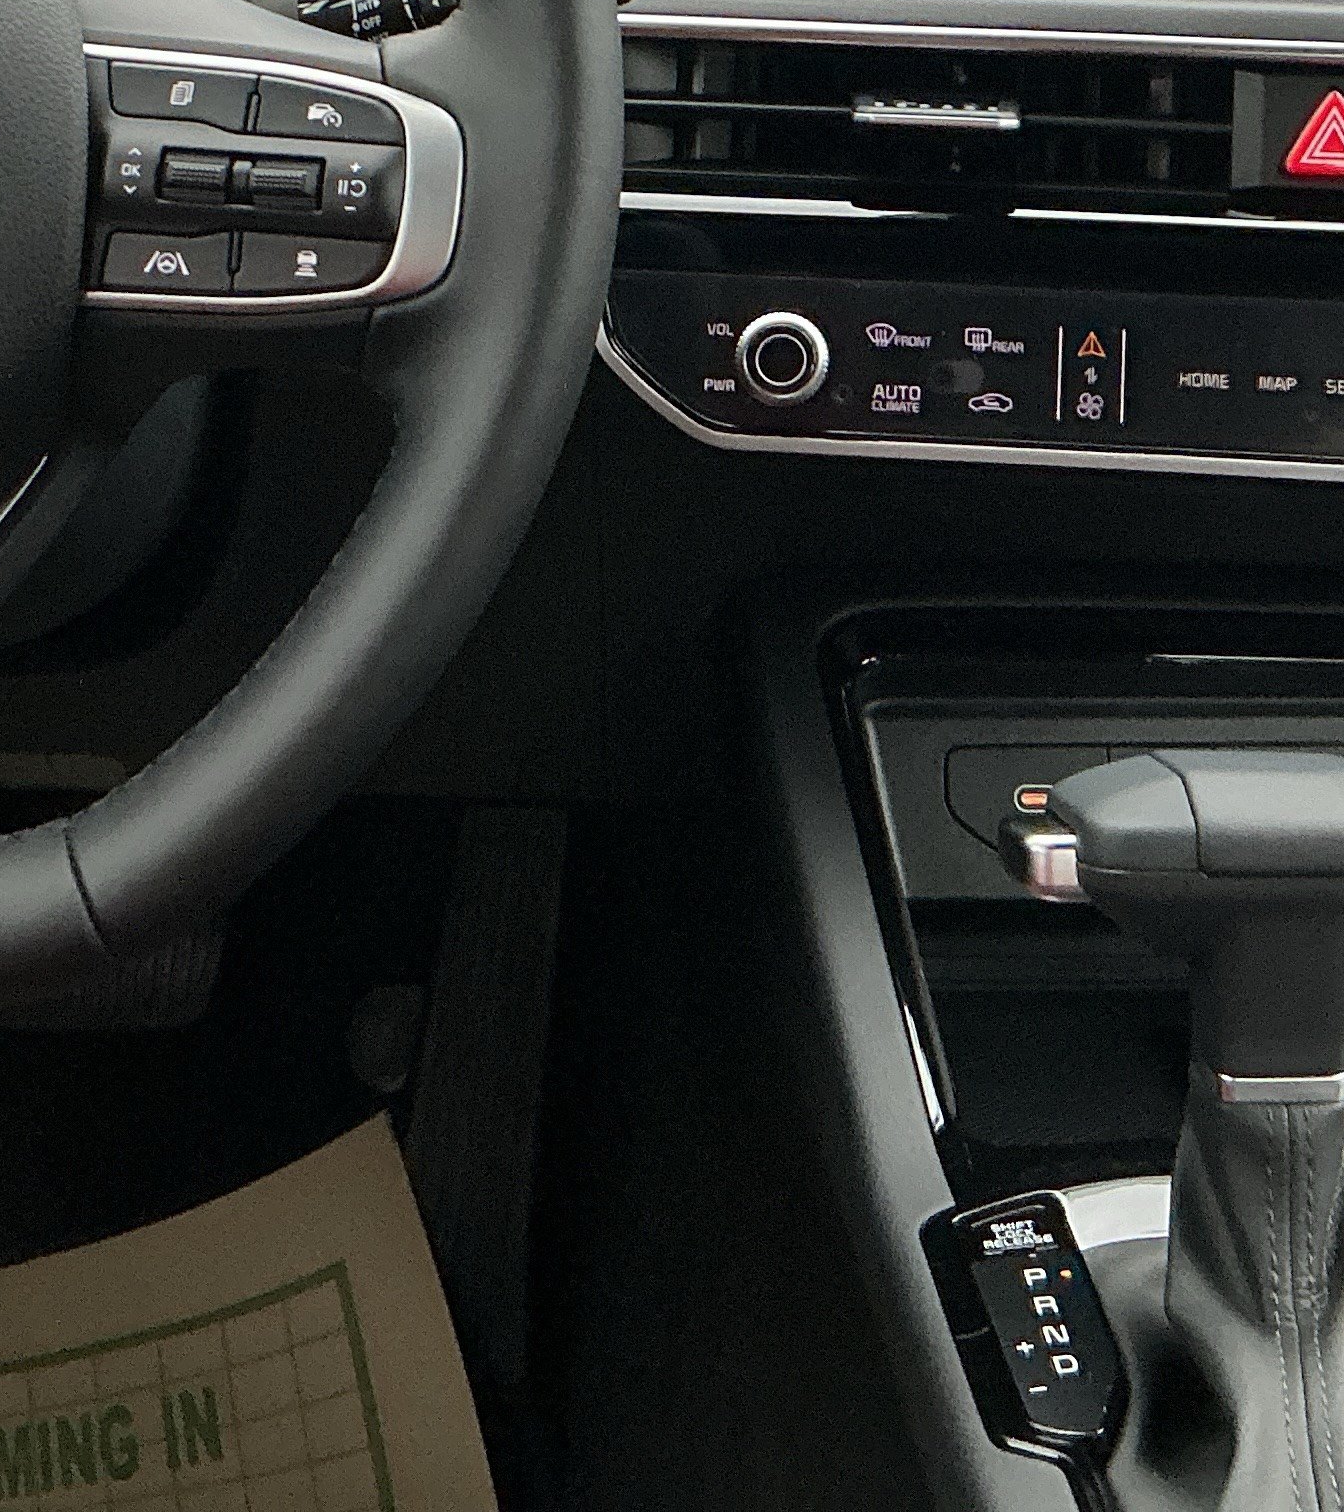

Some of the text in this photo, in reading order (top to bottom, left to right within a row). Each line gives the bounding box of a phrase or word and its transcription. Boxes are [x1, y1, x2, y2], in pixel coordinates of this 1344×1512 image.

[361, 14, 382, 31] OFF
[120, 162, 142, 178] OK
[707, 323, 734, 337] VOL
[894, 334, 932, 349] FRONT
[992, 340, 1025, 354] REAR
[703, 378, 736, 393] PWR
[1179, 372, 1230, 389] HOME
[1258, 376, 1297, 392] MAP
[872, 384, 921, 400] AUTO
[871, 400, 921, 414] CLIMATE
[1023, 1267, 1047, 1288] P
[1033, 1295, 1059, 1316] R
[1042, 1324, 1070, 1346] N
[1052, 1354, 1080, 1376] D
[161, 1385, 226, 1470] IN
